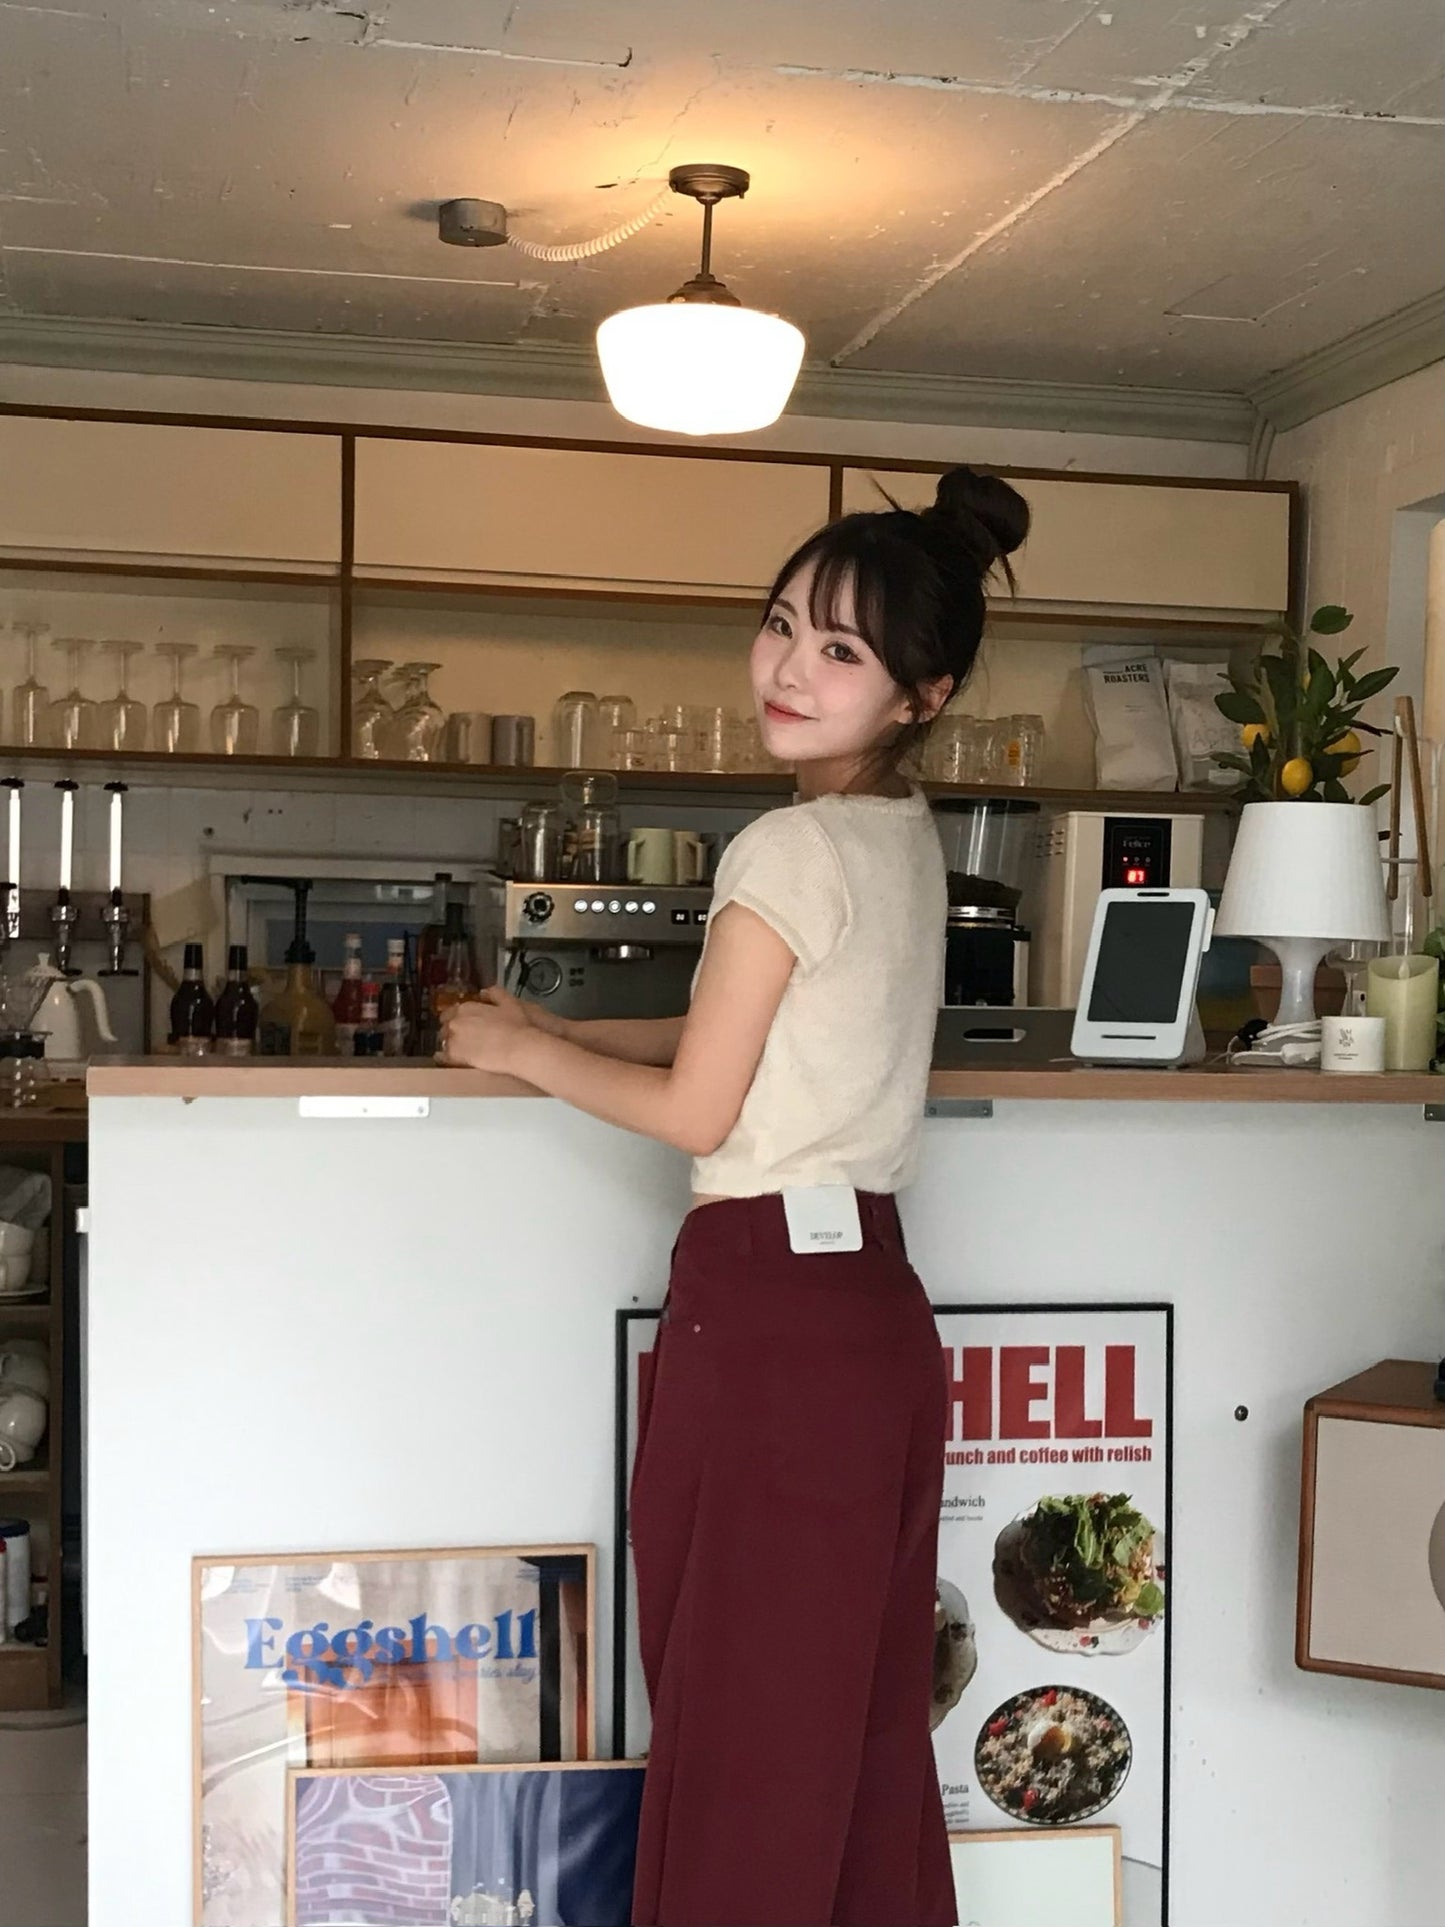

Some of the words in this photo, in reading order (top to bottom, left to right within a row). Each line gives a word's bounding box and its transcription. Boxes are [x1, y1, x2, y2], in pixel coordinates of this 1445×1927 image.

[1124, 663, 1147, 673] ACRE
[1103, 673, 1150, 684] ROASTERS
[941, 1345, 1153, 1441] HELL
[945, 1448, 984, 1465] unch
[986, 1447, 1016, 1464] and
[1019, 1446, 1068, 1464] coffee
[1072, 1446, 1103, 1463] with
[1107, 1445, 1152, 1462] relish
[940, 1495, 986, 1508] andwich
[243, 1608, 538, 1689] Eggshell
